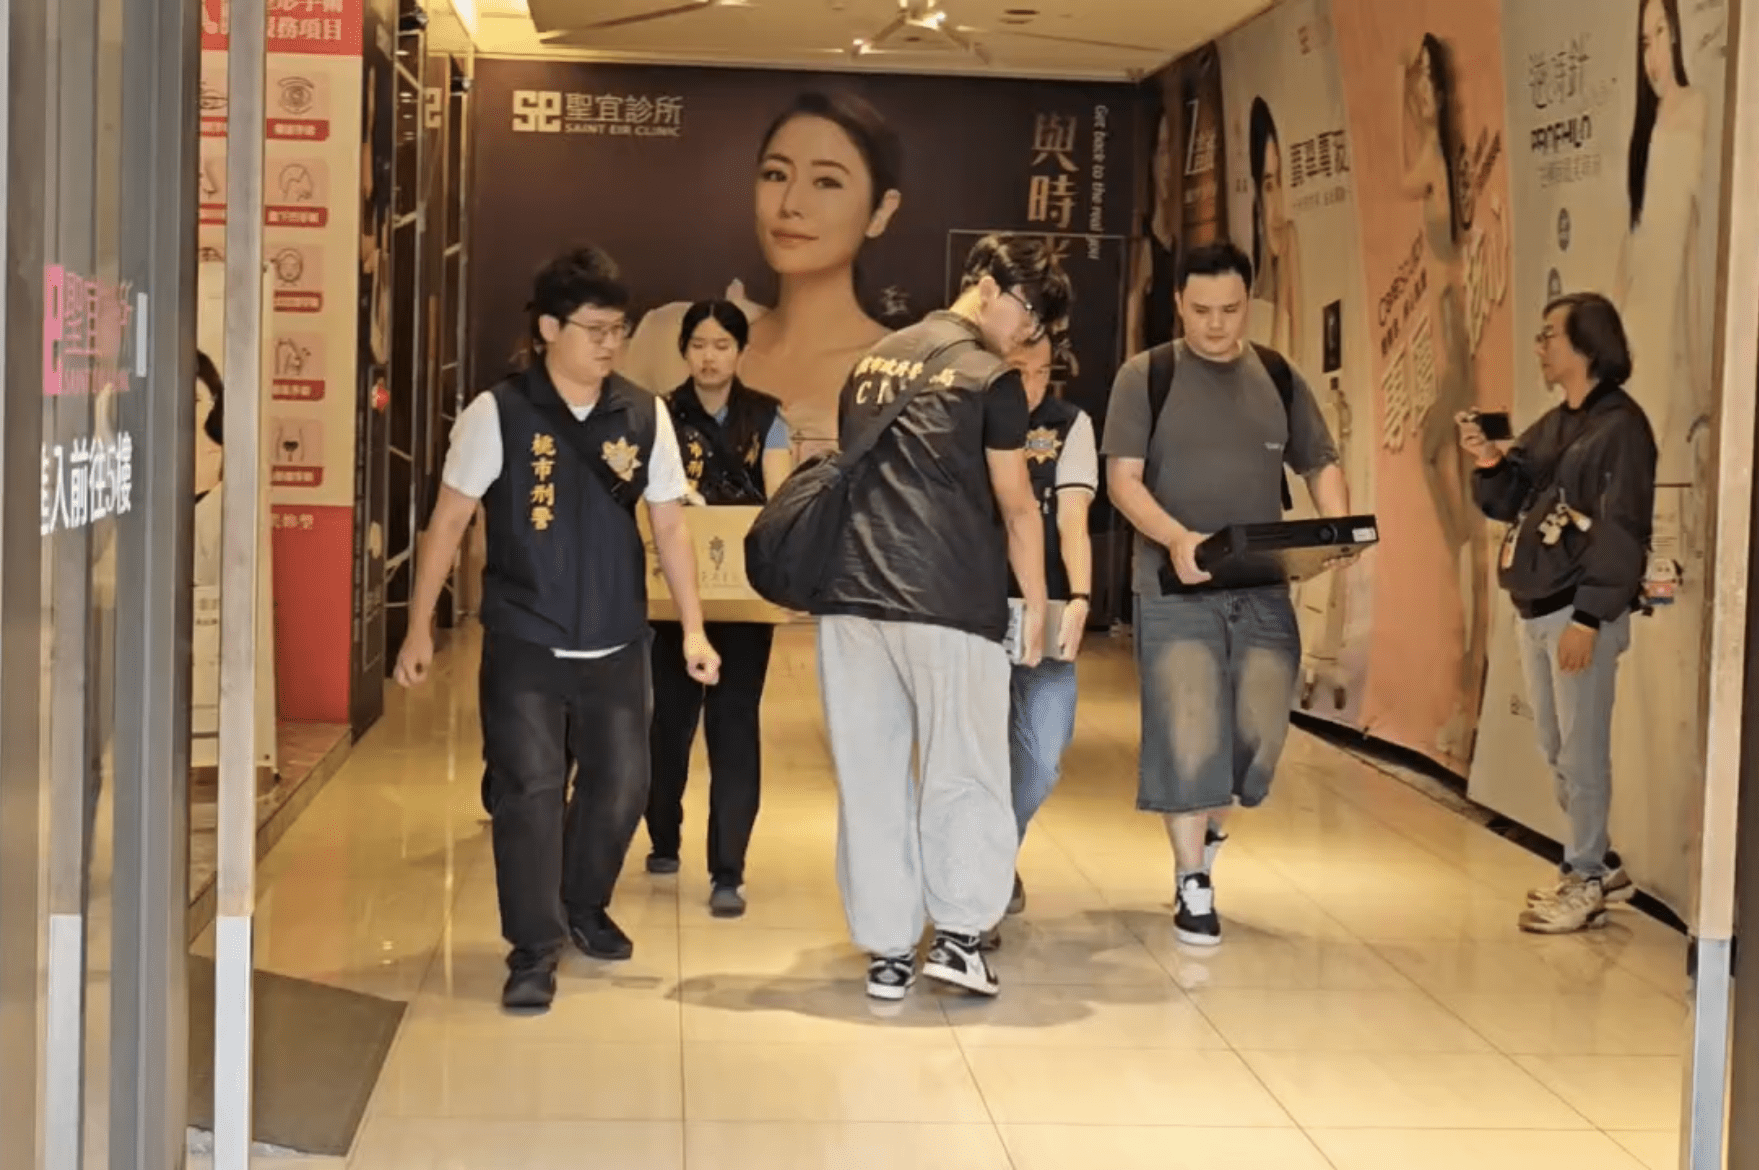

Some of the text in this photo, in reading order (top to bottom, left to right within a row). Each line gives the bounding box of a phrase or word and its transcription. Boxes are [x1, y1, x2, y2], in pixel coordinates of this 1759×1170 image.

[564, 92, 684, 125] 聖宜診所
[564, 124, 605, 134] SAINT
[634, 126, 681, 137] CLINIC
[1091, 130, 1108, 163] back
[530, 432, 557, 531] 桃市刑警
